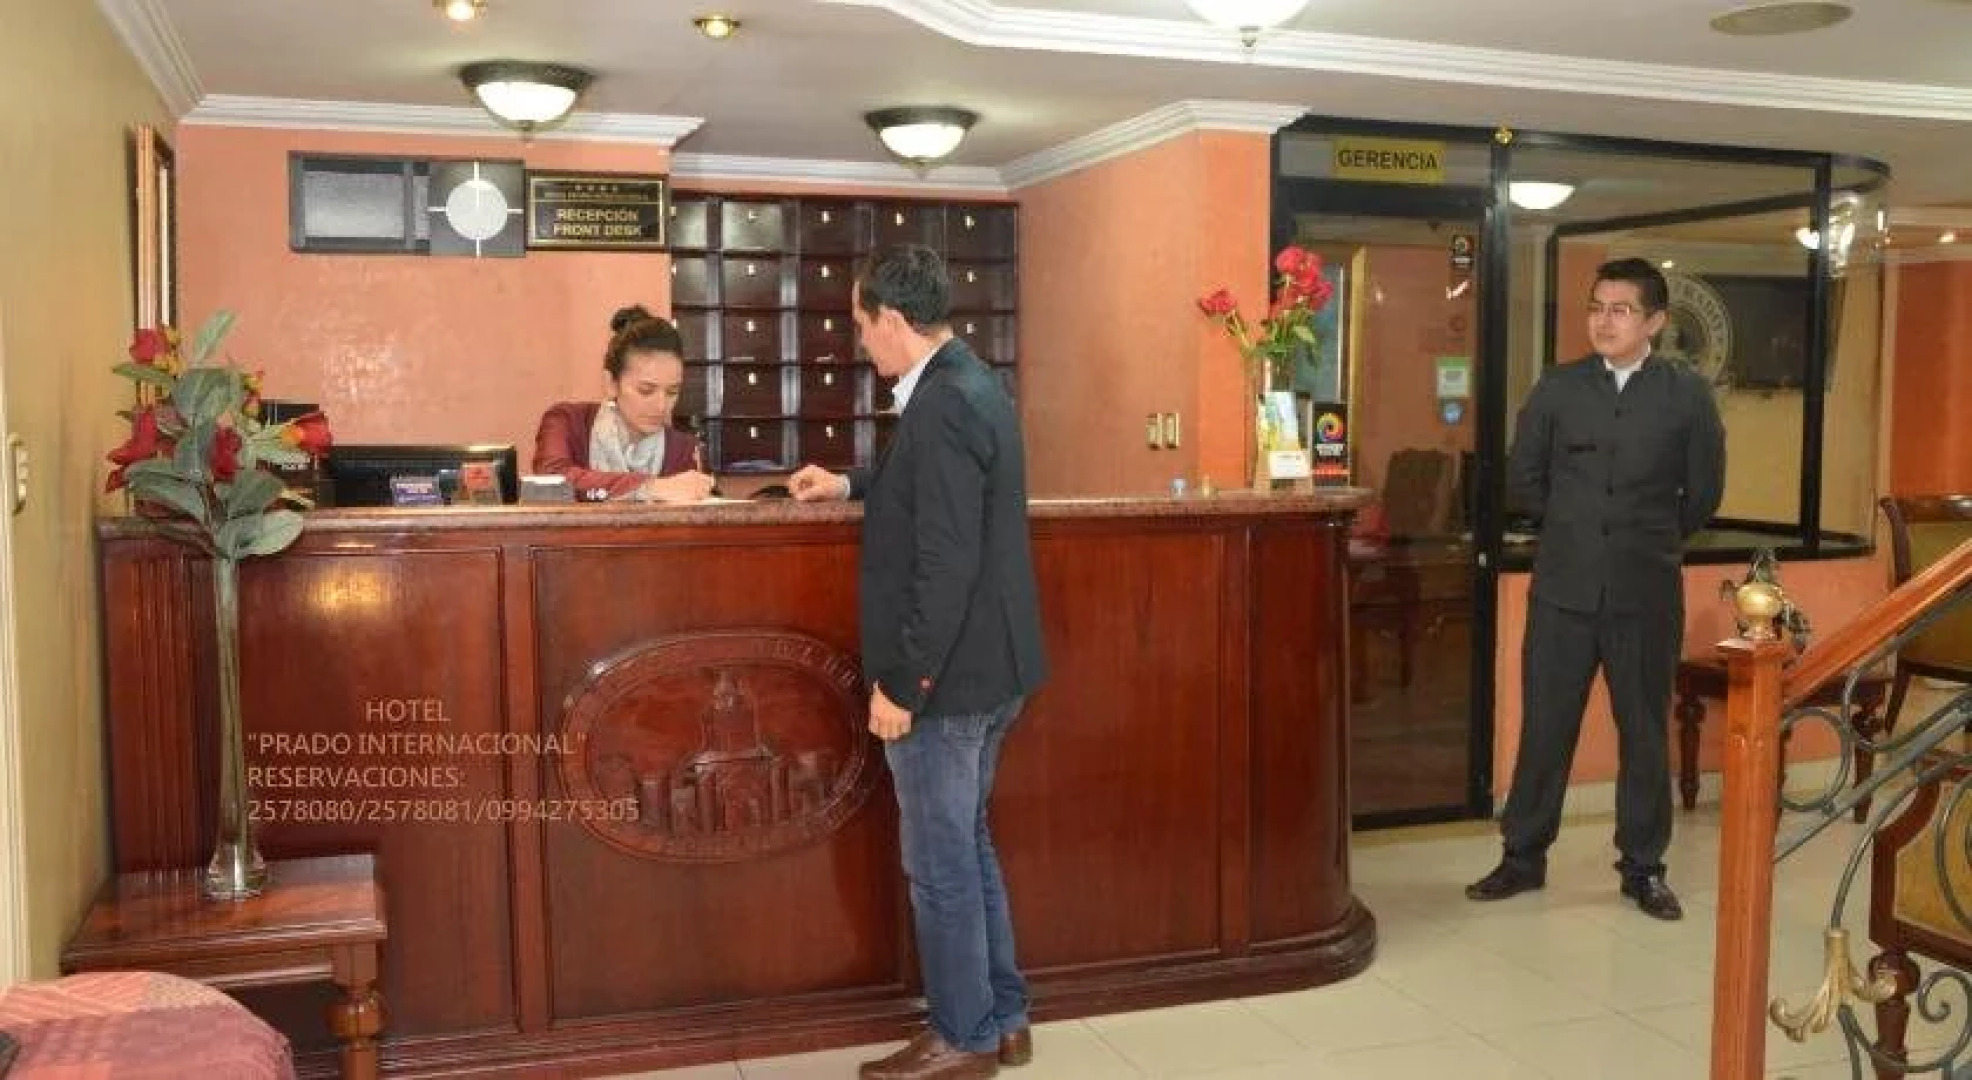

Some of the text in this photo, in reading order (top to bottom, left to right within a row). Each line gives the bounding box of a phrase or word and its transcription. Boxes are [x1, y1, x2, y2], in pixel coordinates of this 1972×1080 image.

[1337, 149, 1439, 170] GERENCIA
[553, 223, 642, 237] FRONT DESK
